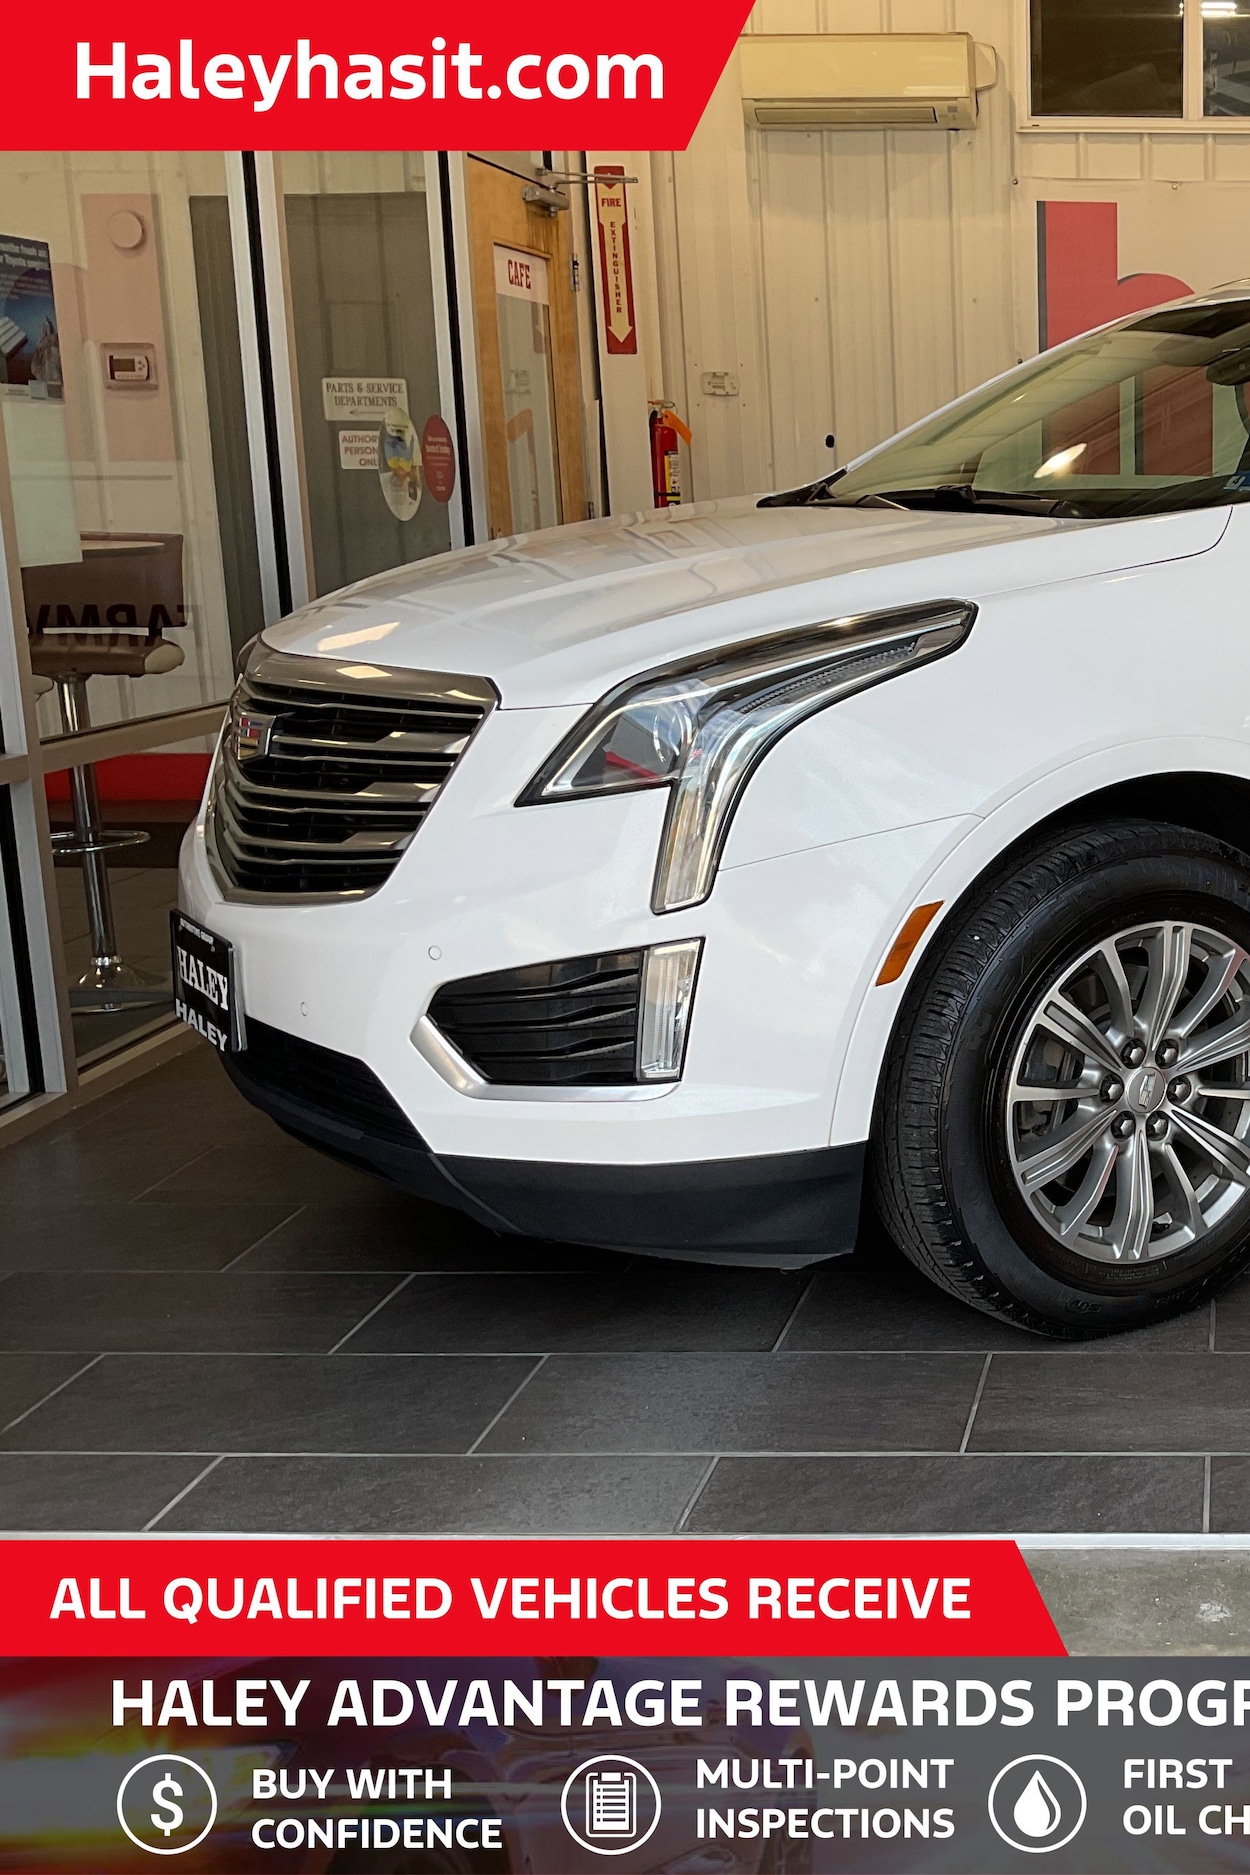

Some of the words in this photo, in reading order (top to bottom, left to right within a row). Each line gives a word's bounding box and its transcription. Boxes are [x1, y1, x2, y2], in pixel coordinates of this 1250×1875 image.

[601, 198, 622, 207] FIRE
[610, 221, 622, 313] EXTINGUISHER
[508, 259, 531, 290] CAFE
[326, 382, 353, 393] PARTS
[356, 382, 363, 393] &
[366, 383, 403, 394] SERVICE
[334, 395, 397, 407] DEPARTMENTS
[342, 435, 379, 443] AUTHOR
[344, 446, 379, 454] PERSON
[359, 458, 378, 466] ONL
[177, 945, 228, 1011] HALEY
[175, 998, 228, 1052] HALEY
